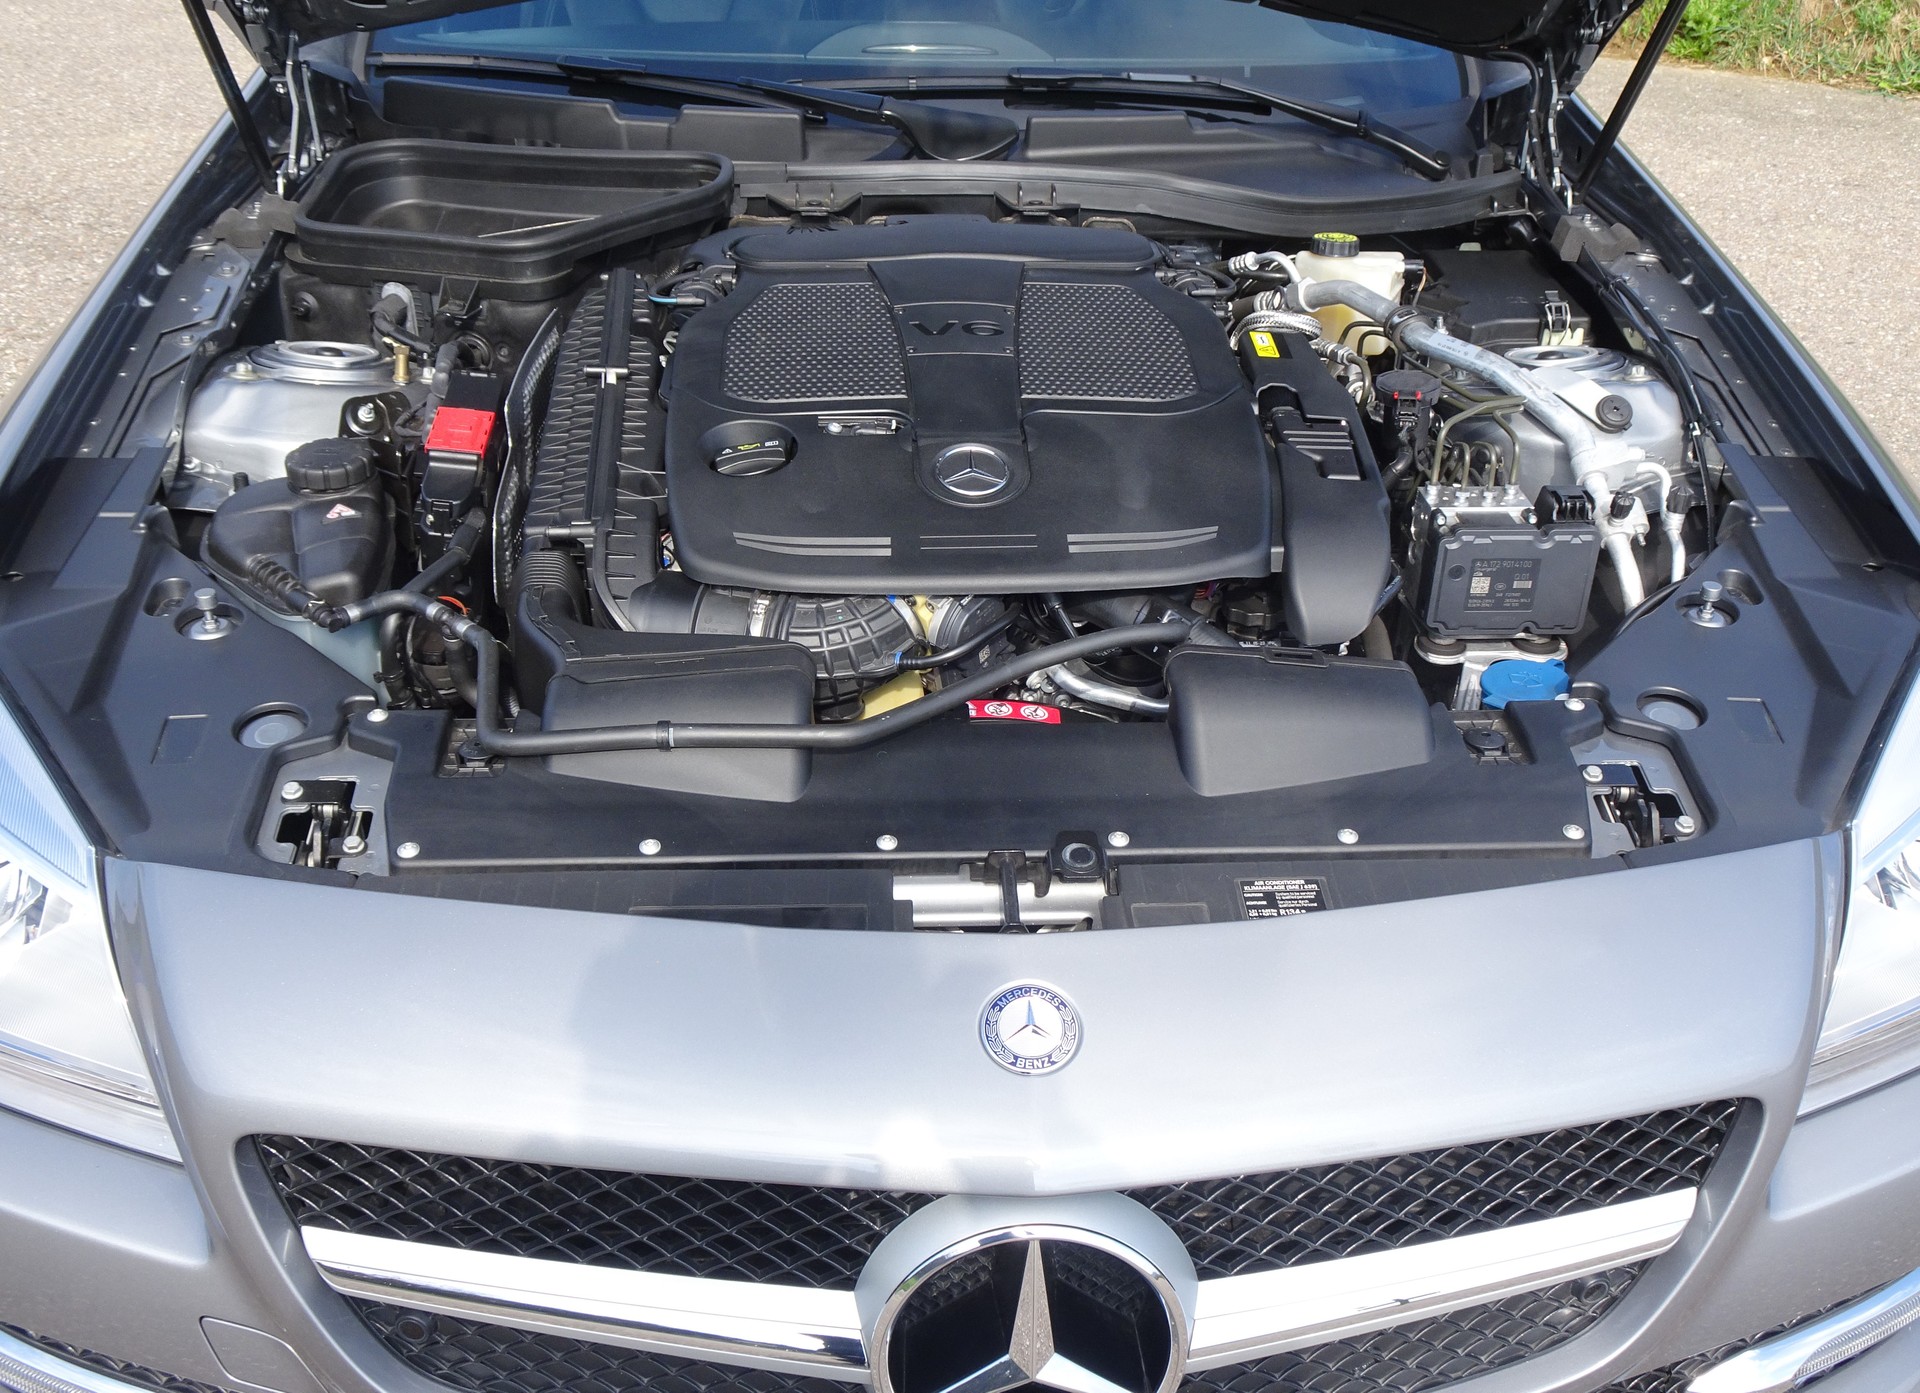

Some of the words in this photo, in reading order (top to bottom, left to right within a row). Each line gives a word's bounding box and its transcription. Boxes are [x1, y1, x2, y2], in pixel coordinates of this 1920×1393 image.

[908, 320, 1004, 336] V6
[996, 987, 1062, 1008] MERCEDES
[1015, 1056, 1052, 1069] BENZ
